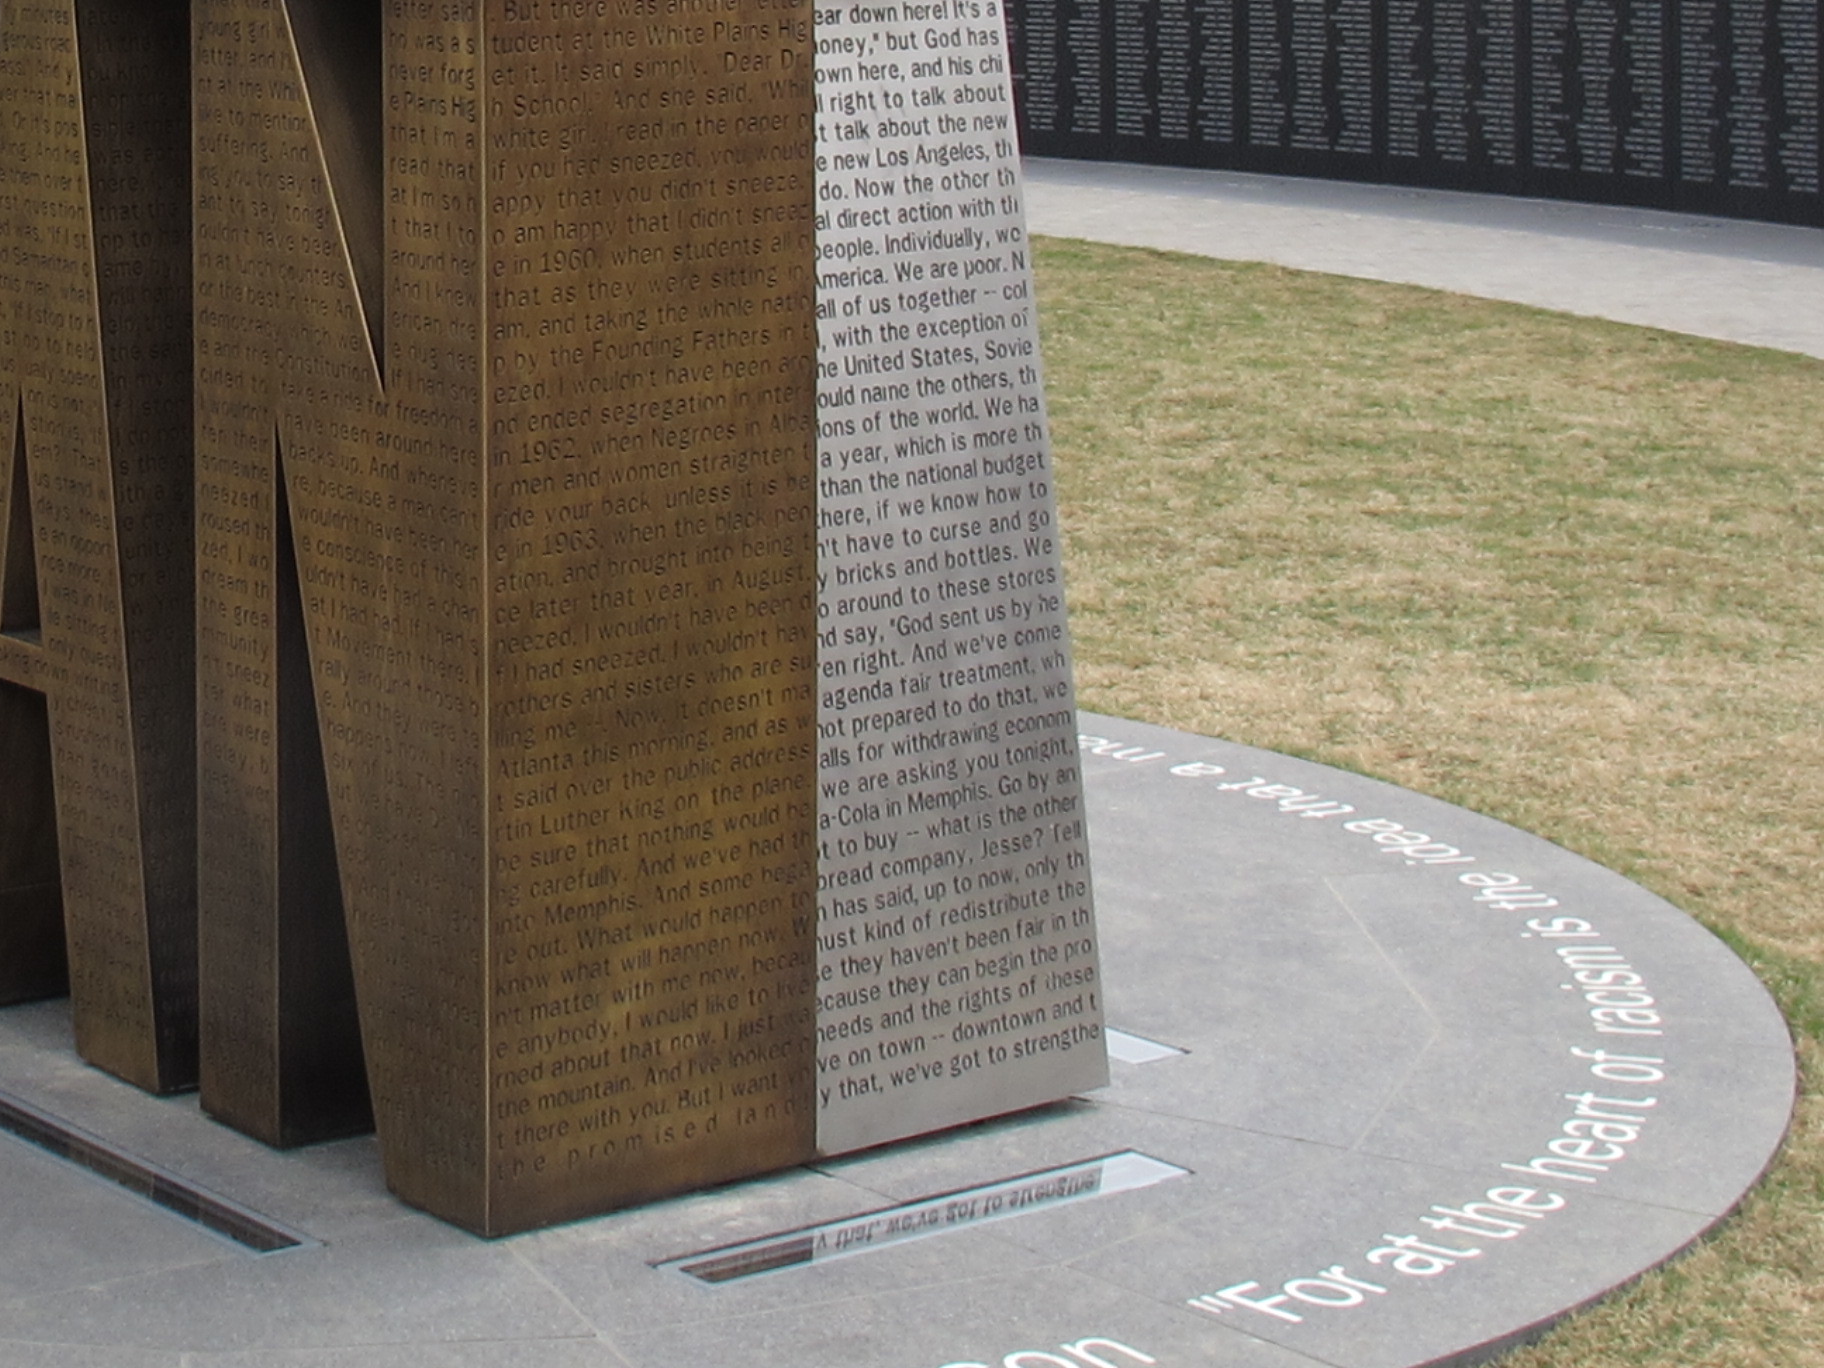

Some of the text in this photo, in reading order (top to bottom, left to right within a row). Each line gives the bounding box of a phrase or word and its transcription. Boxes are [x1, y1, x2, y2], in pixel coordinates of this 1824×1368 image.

[849, 0, 998, 25] down here! It's a
[820, 451, 1046, 499] than the national budget
[835, 536, 1053, 586] bricks and bottles. We
[821, 736, 1074, 799] we are asking you tonight,
[1169, 761, 1226, 778] a
[1216, 775, 1356, 819] that
[1342, 817, 1476, 866] idea
[1458, 871, 1560, 911] the
[1520, 916, 1601, 938] is
[1555, 945, 1664, 1036] racism
[838, 1022, 1100, 1100] that, we've got to strengthe
[1569, 1045, 1665, 1084] of
[1500, 1091, 1658, 1184] heart
[1420, 1185, 1567, 1240] the
[1365, 1233, 1482, 1276] at
[1186, 1264, 1388, 1324] "For
